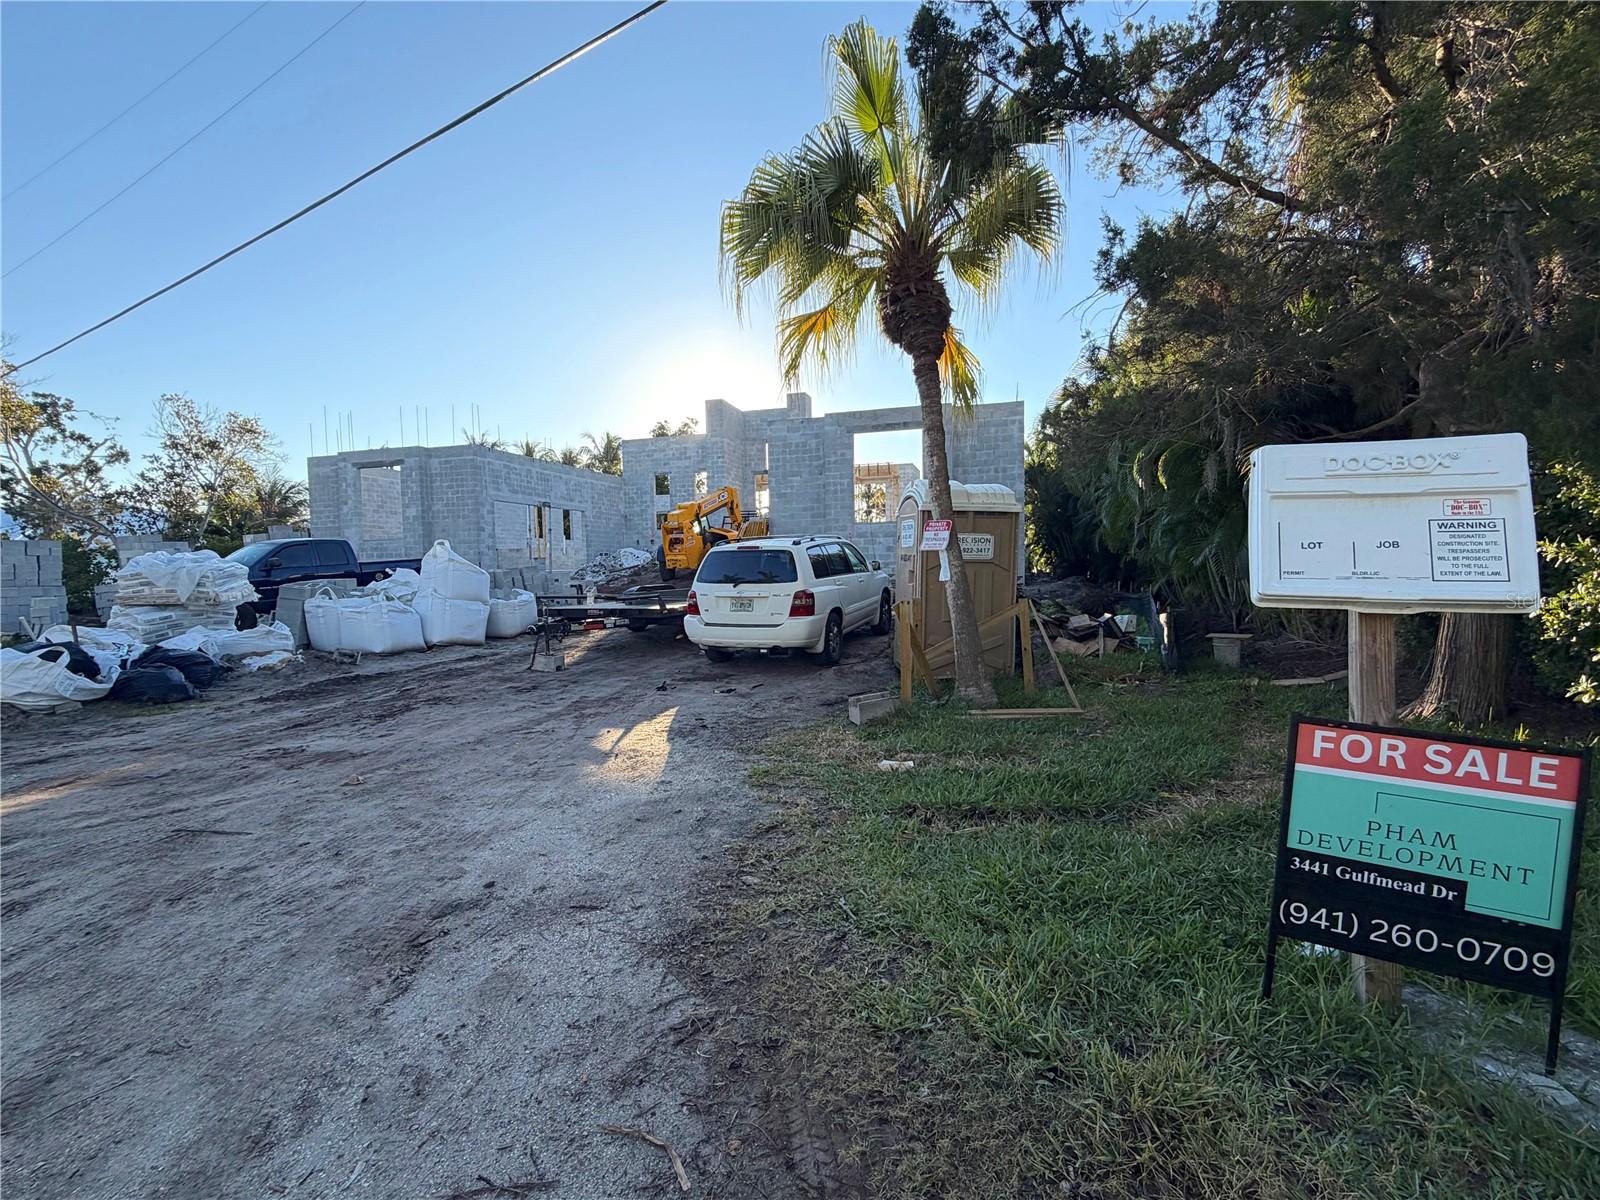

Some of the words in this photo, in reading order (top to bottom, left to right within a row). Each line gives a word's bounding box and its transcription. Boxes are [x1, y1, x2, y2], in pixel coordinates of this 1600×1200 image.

[957, 536, 991, 544] RECISION
[1437, 521, 1497, 529] WARNING
[1301, 541, 1324, 549] LOT
[1376, 541, 1400, 549] JOB
[1312, 729, 1407, 770] FOR
[1423, 744, 1560, 790] SALE
[1366, 820, 1458, 851] PHAM
[1297, 829, 1535, 886] DEVELOPMENT
[1290, 857, 1329, 876] 3441
[1335, 866, 1425, 895] Gulfmead
[1432, 884, 1458, 901] Dr
[1279, 899, 1359, 939] (941)
[1369, 919, 1556, 978] 260-0709
